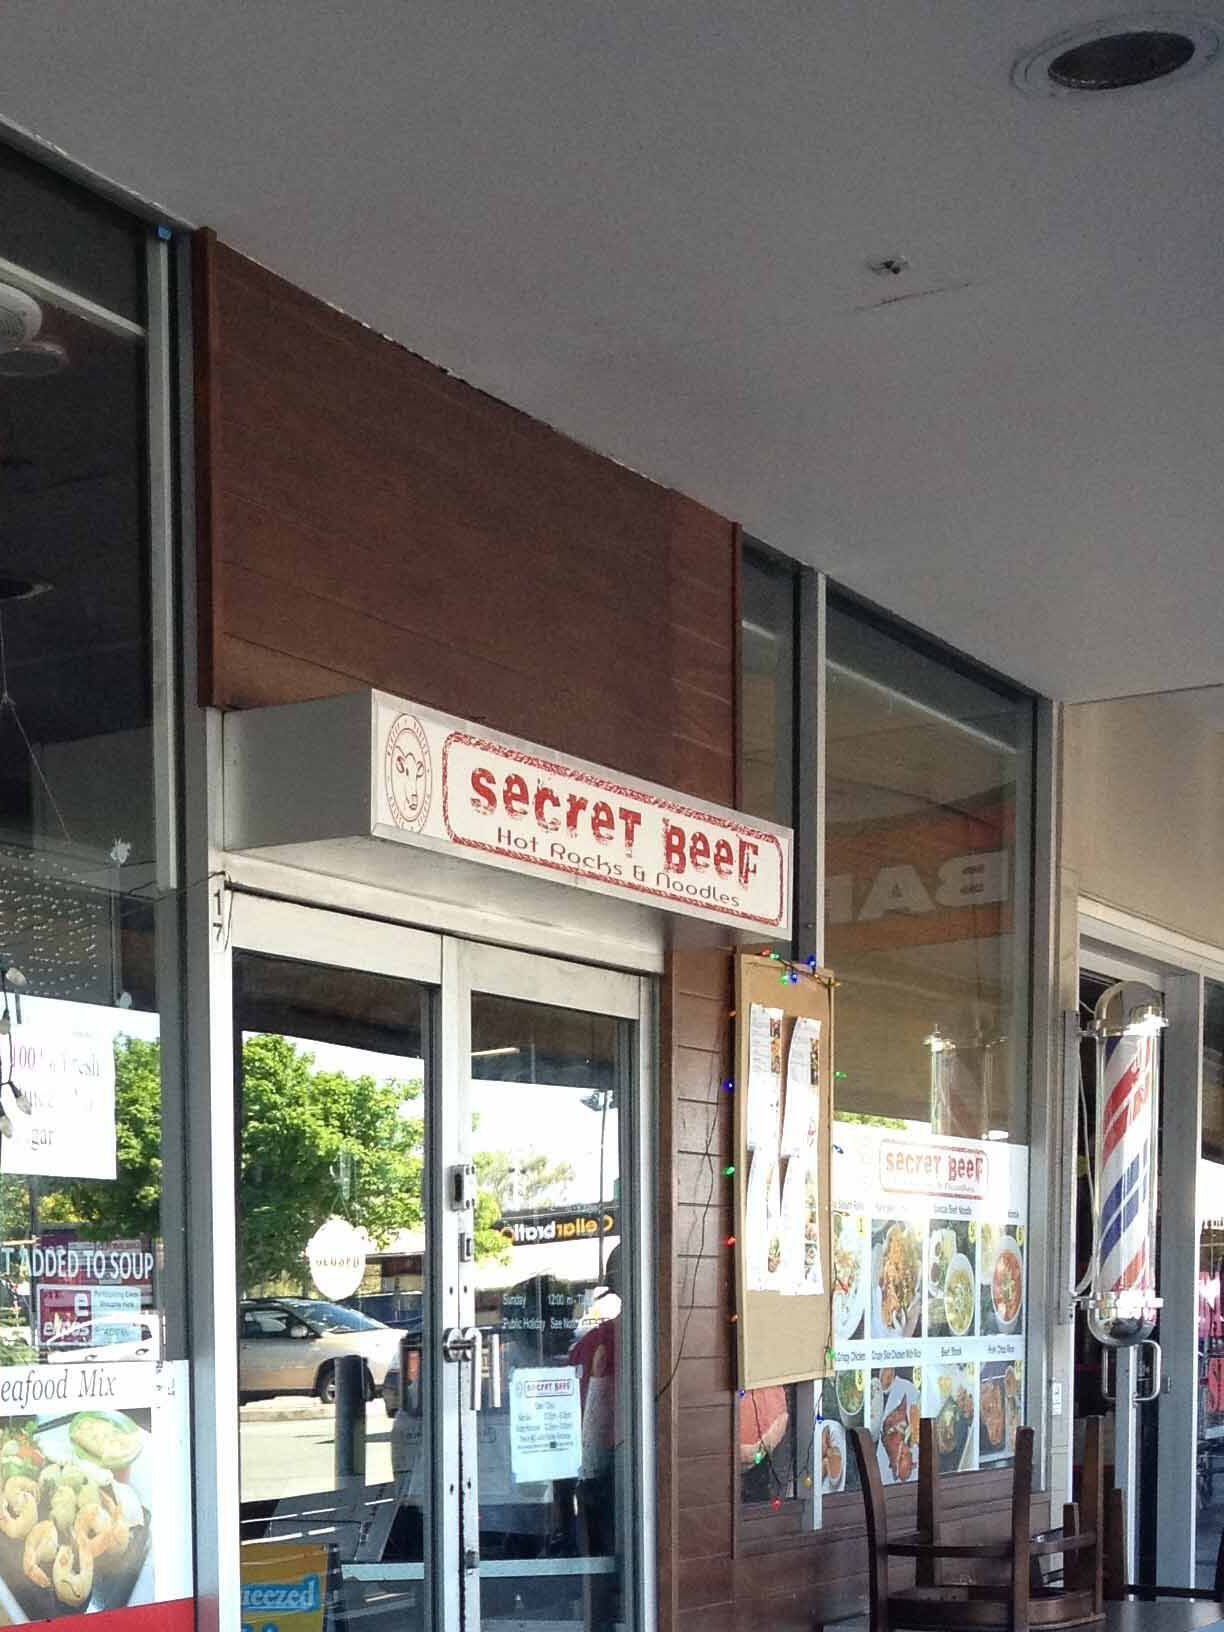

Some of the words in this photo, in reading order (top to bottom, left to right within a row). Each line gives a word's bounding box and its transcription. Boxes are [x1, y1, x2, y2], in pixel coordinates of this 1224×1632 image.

[497, 827, 537, 853] Hot
[550, 843, 623, 876] Rocks
[656, 873, 740, 907] Noodles
[19, 1248, 77, 1278] ADDED
[84, 1249, 106, 1279] TO
[110, 1251, 154, 1280] SOUP
[78, 1368, 117, 1398] Mix
